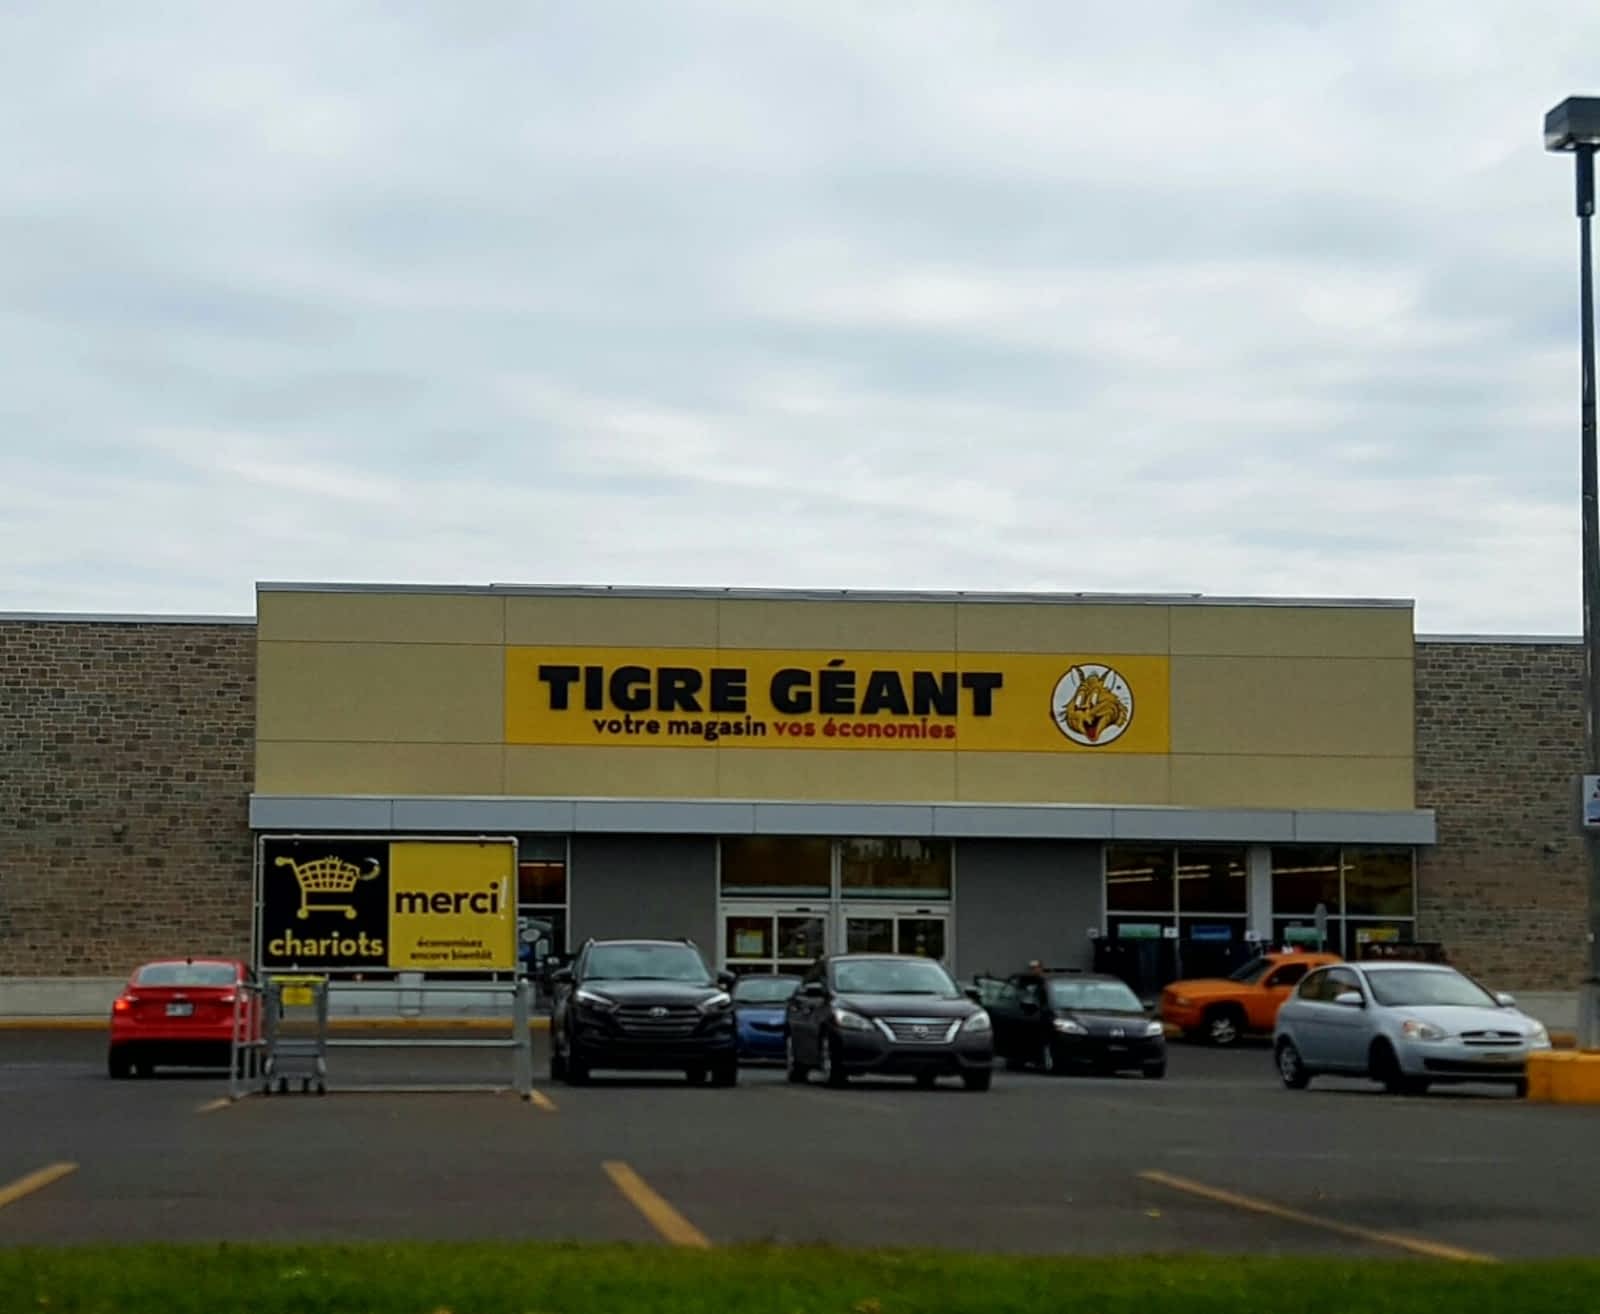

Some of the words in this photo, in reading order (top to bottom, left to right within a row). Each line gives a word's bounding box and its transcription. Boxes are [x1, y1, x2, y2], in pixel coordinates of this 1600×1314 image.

[538, 664, 747, 713] TIGRE
[769, 658, 1004, 717] GÉANT
[593, 713, 661, 735] votre
[667, 715, 767, 742] magasin
[773, 720, 816, 737] vos
[822, 717, 957, 739] économies
[268, 928, 384, 956] chariots
